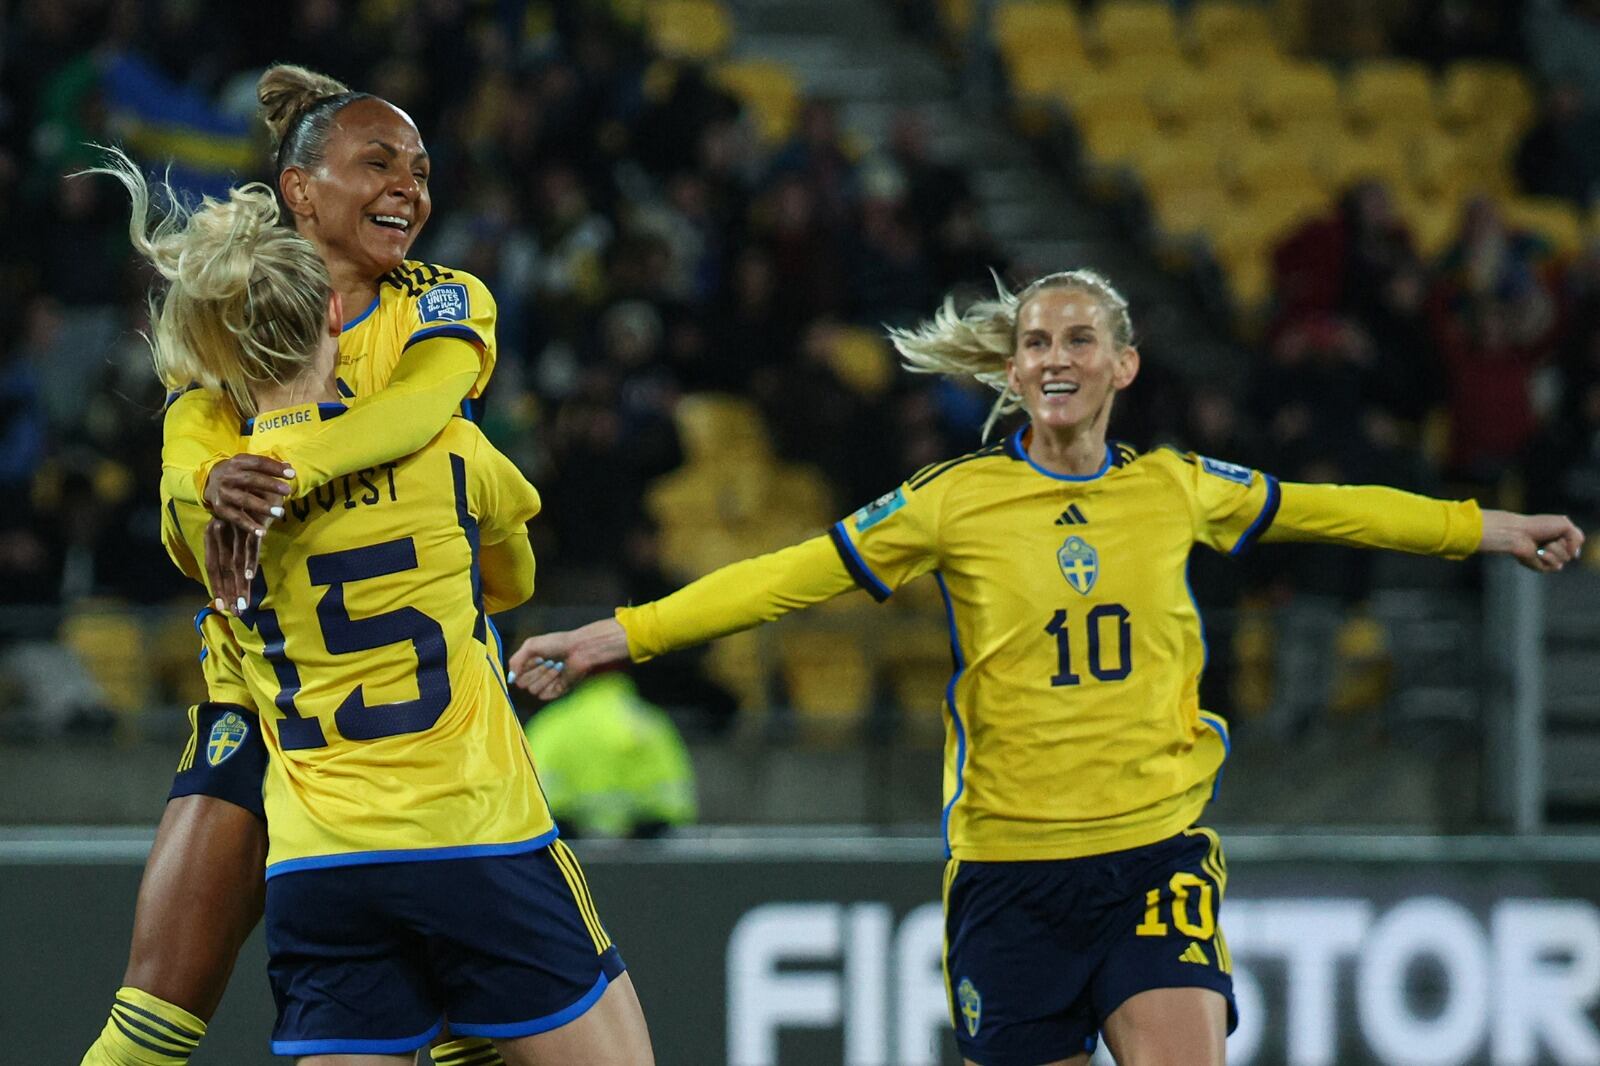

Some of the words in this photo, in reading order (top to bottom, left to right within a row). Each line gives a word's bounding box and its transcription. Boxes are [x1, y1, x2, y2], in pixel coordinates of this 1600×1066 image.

[427, 293, 460, 305] UNITES
[258, 409, 312, 433] SVERIGE
[239, 536, 452, 751] 15
[1044, 603, 1132, 687] 10
[1136, 872, 1216, 940] 10
